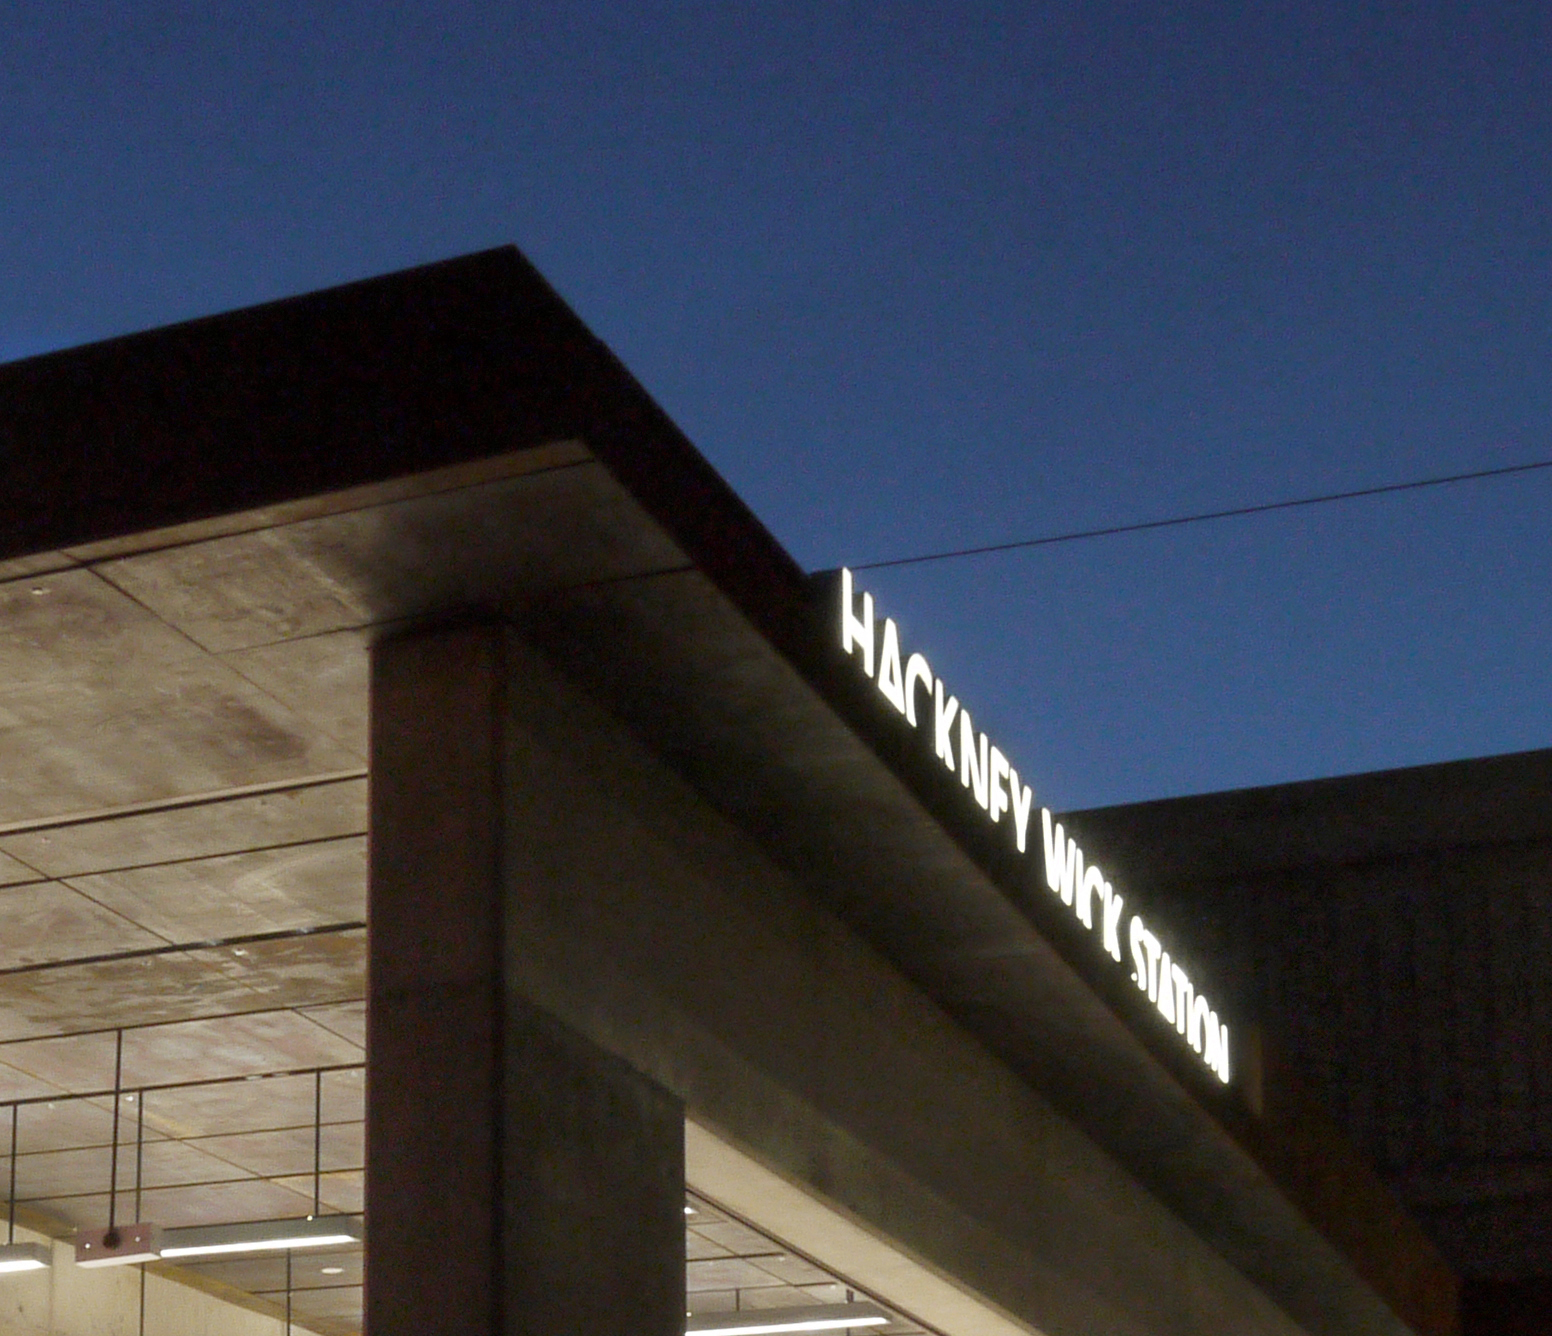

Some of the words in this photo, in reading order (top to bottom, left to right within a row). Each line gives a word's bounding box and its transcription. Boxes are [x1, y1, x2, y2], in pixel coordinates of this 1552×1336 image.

[842, 566, 1032, 853] HACKNEY
[1042, 806, 1124, 963] WICK
[1130, 915, 1230, 1084] STATION
